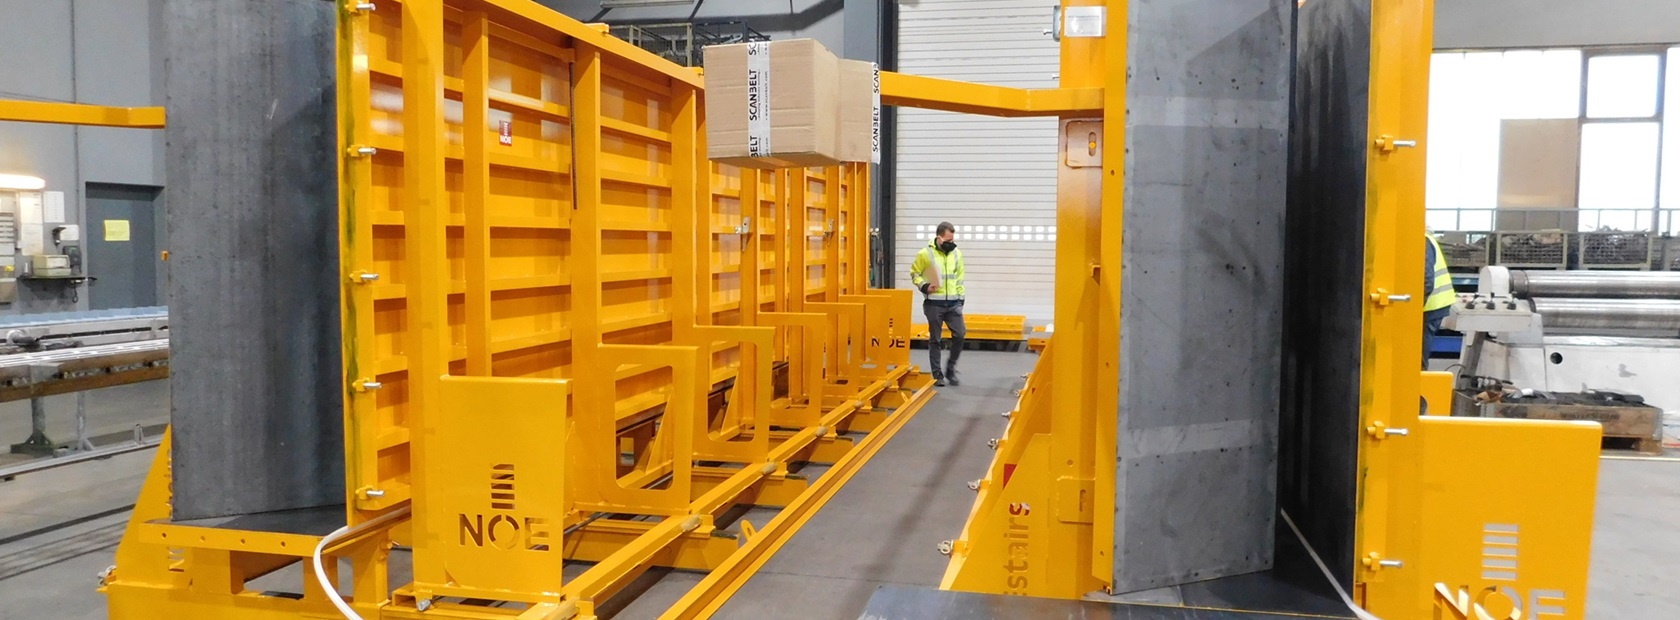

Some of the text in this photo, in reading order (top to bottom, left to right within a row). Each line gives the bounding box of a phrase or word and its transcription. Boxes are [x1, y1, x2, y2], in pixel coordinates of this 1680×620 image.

[749, 70, 758, 121] SCANBELT
[459, 513, 550, 551] NOE
[1003, 502, 1031, 597] stairs
